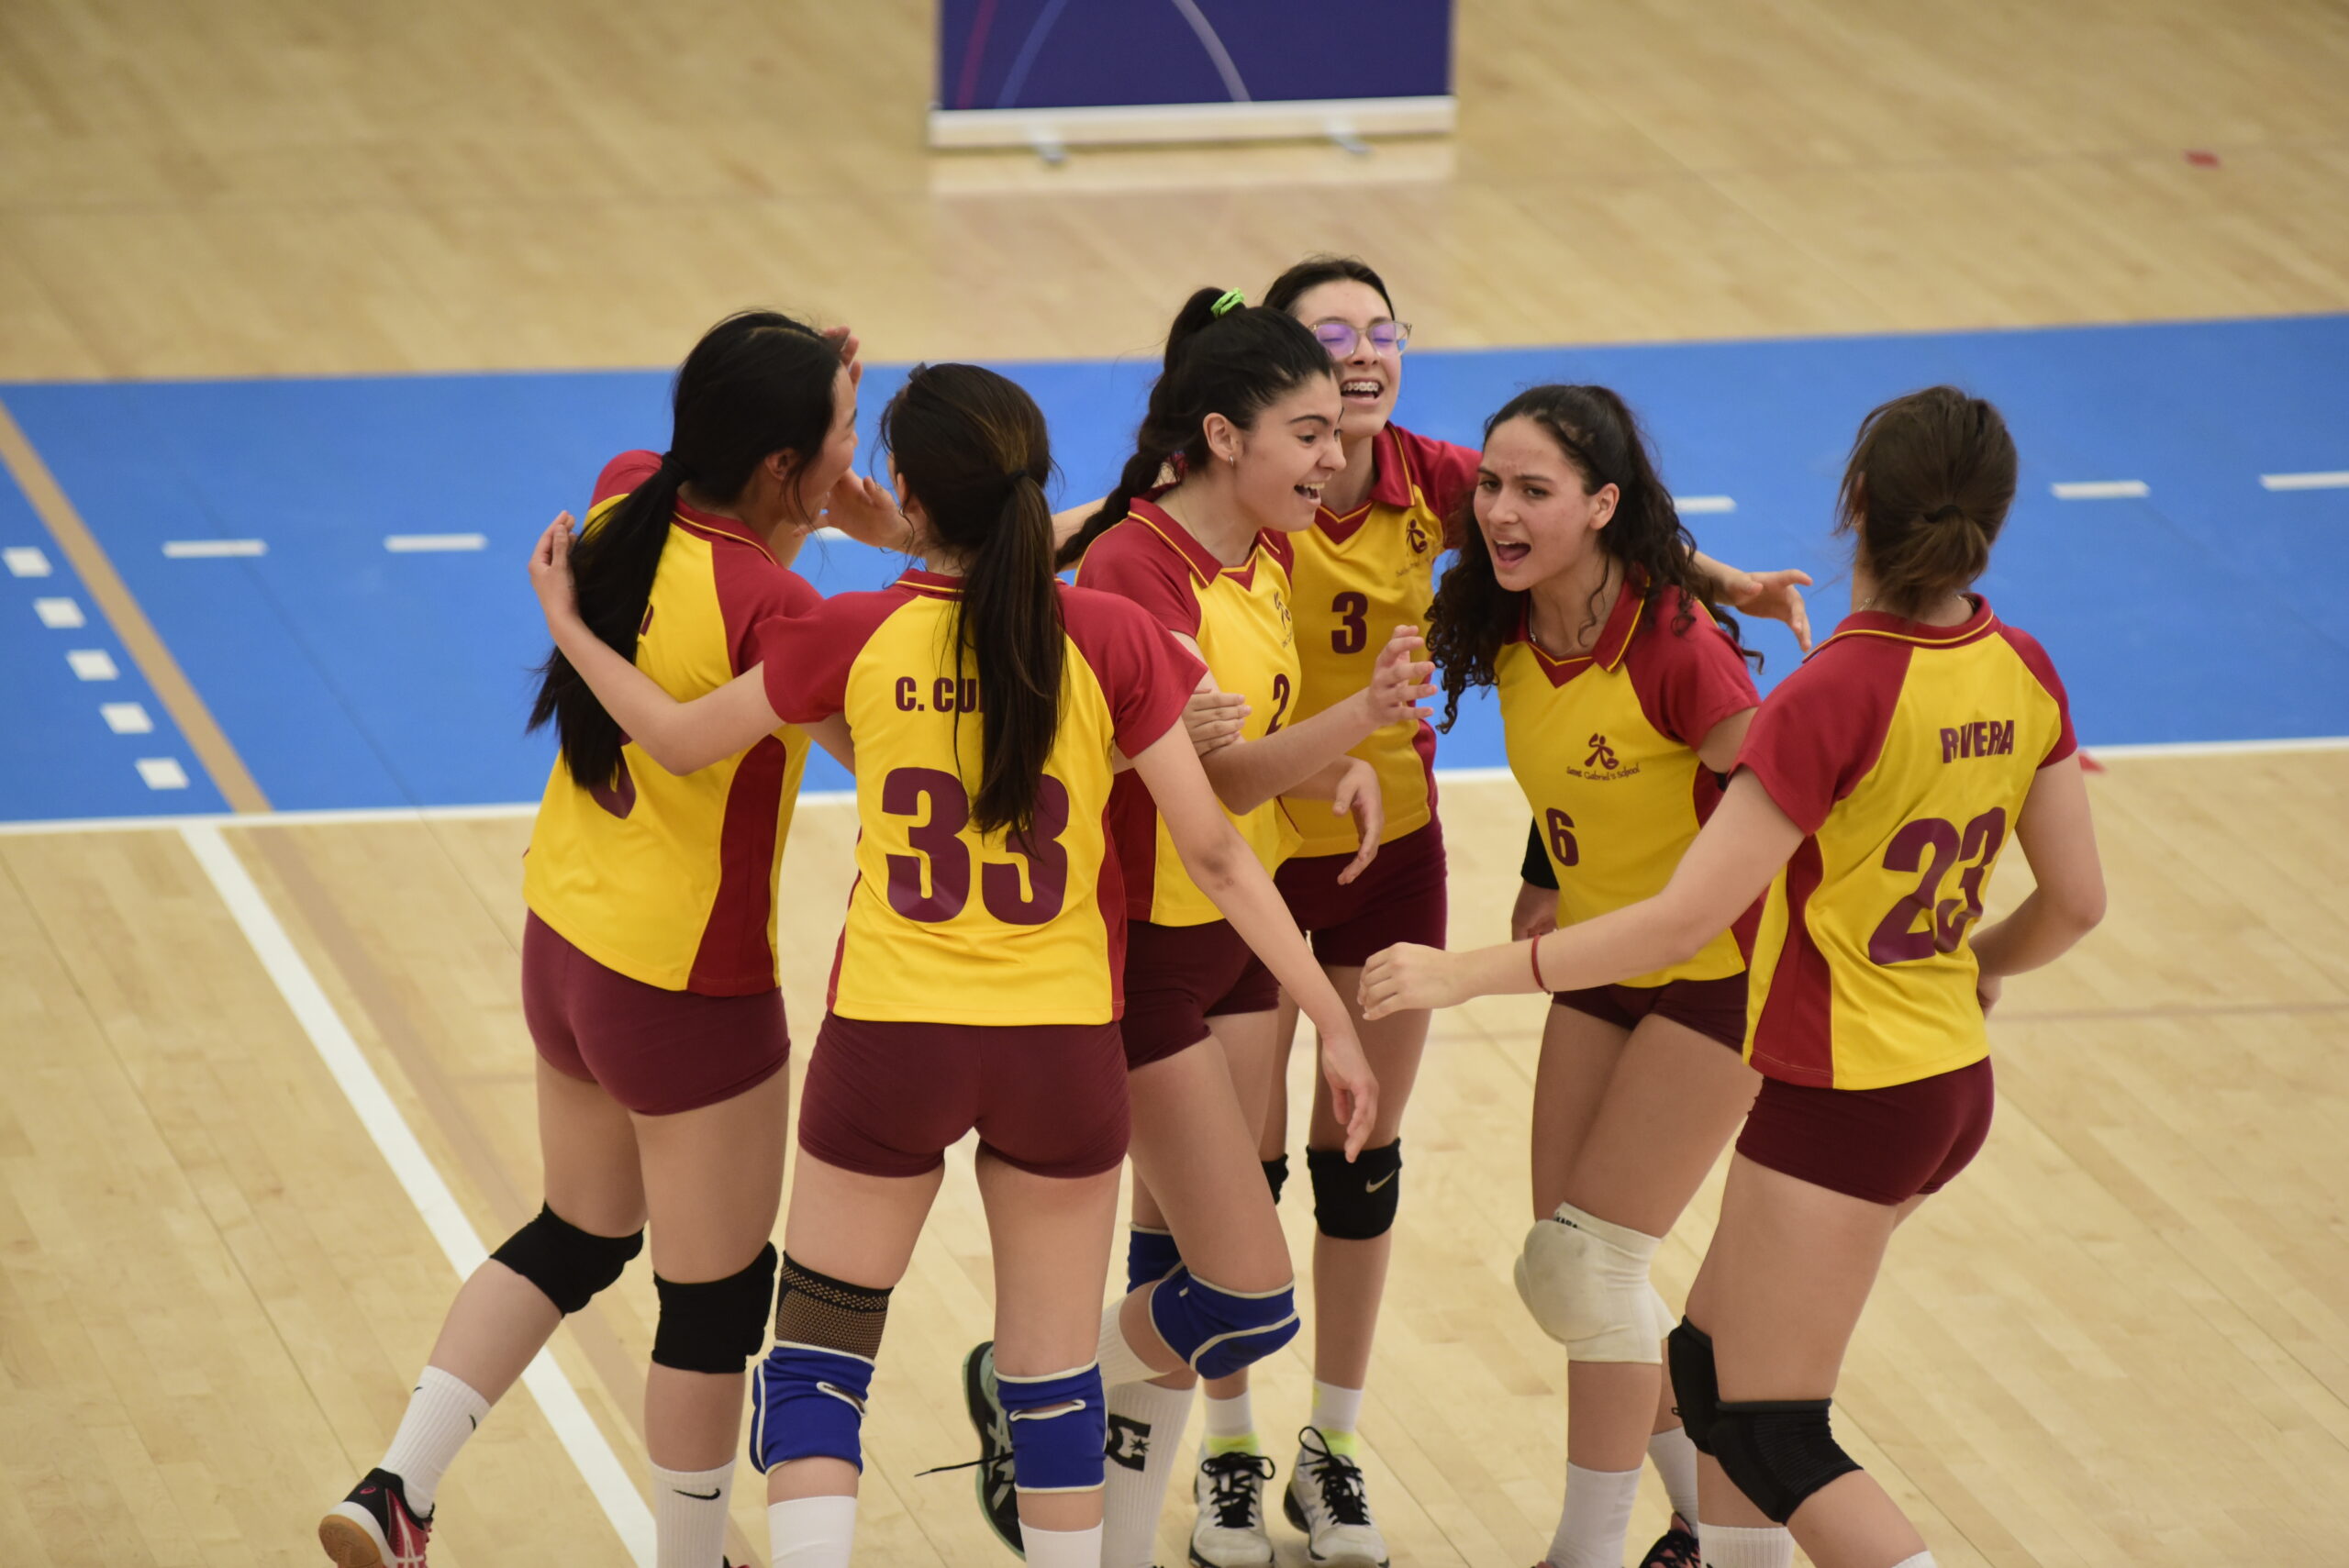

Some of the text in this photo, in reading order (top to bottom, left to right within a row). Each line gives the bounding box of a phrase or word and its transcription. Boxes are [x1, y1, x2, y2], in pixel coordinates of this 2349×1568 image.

[1331, 592, 1368, 654] 3
[895, 676, 985, 713] C. CU
[1266, 673, 1290, 736] 2
[882, 767, 1070, 926] 33
[1546, 807, 1579, 866] 6
[1868, 806, 2006, 966] 23
